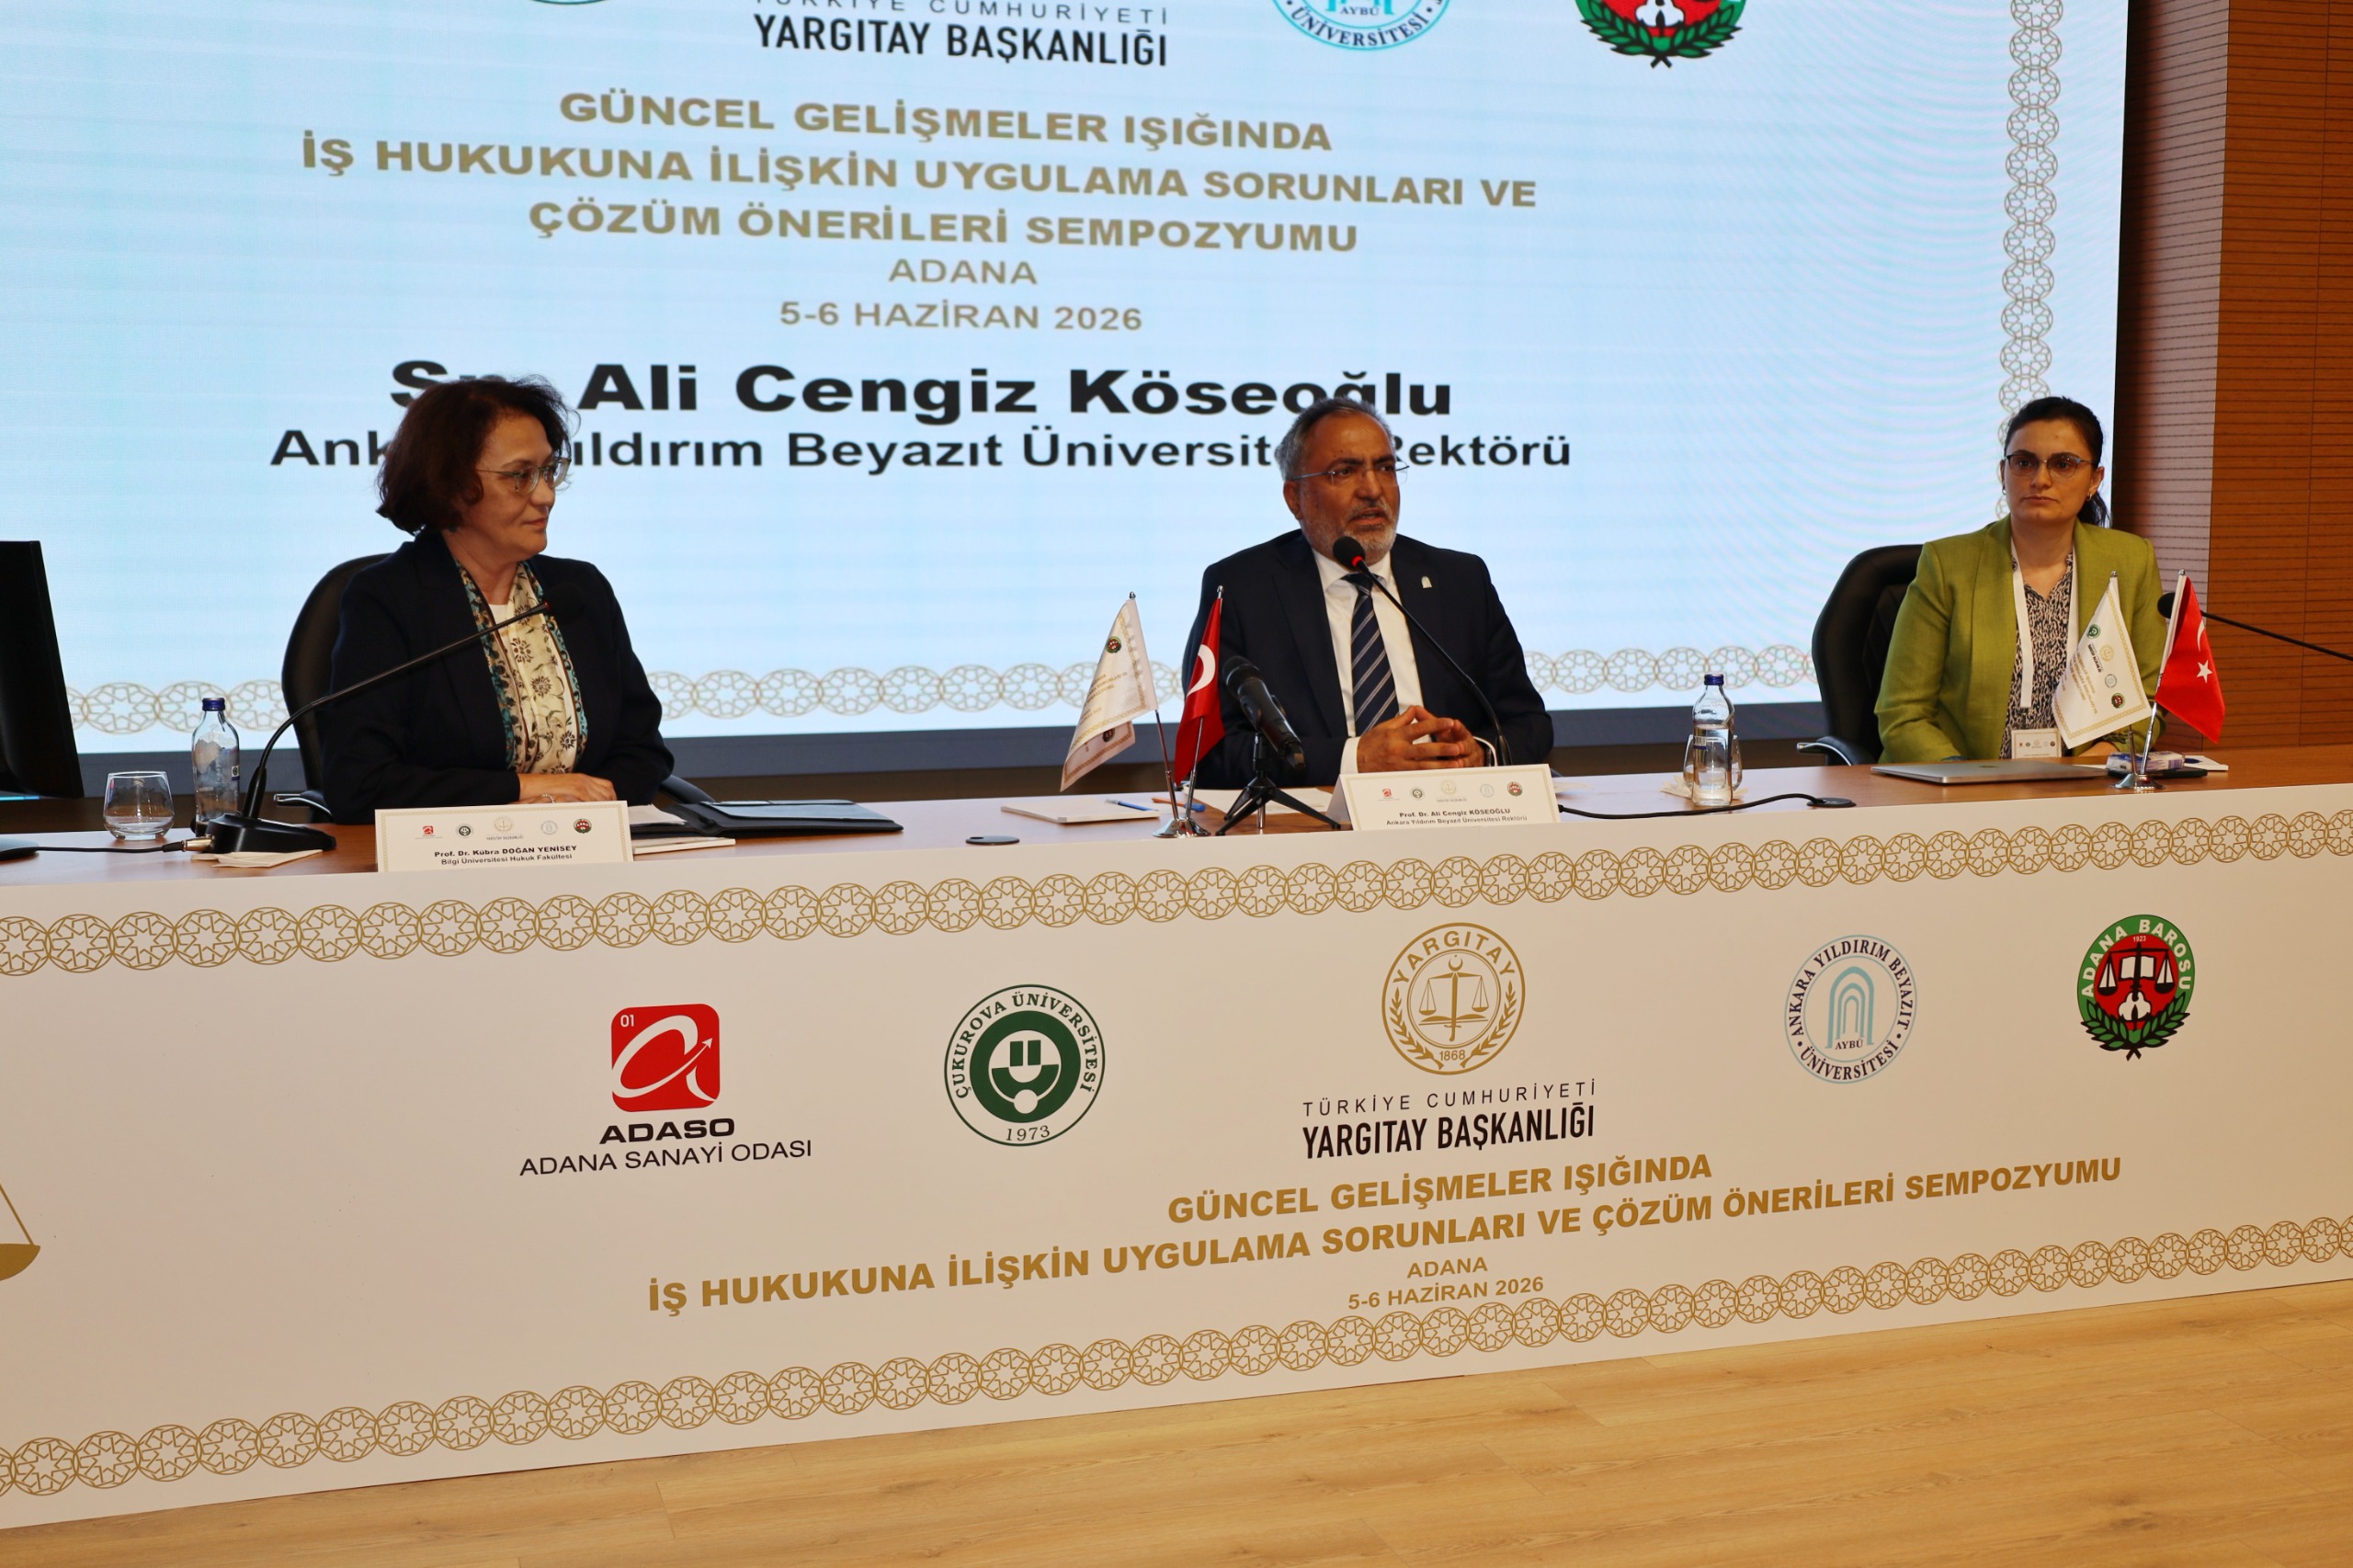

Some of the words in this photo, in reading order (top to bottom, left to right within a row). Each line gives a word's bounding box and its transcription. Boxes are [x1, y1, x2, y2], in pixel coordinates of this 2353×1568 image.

[929, 0, 1167, 25] CUMHURİYETİ
[1290, 6, 1430, 47] ÜNİVERSİTESİ
[1340, 6, 1379, 17] AYBÜ
[753, 13, 930, 55] YARGITAY
[947, 23, 1166, 67] BAŞKANLIĞI
[559, 87, 776, 131] GÜNCEL
[794, 98, 1108, 144] GELİŞMELER
[1124, 112, 1333, 152] IŞIĞINDA
[302, 130, 355, 177] İŞ
[376, 140, 694, 182] HUKUKUNA
[710, 144, 898, 191] İLİŞKİN
[915, 160, 1188, 198] UYGULAMA
[1203, 170, 1463, 206] SORUNLARI
[1481, 178, 1537, 209] VE
[529, 197, 721, 238] ÇÖZÜM
[737, 202, 1007, 244] ÖNERİLERİ
[1026, 216, 1358, 253] SEMPOZYUMU
[888, 258, 1038, 286] ADANA
[779, 301, 839, 326] 5-6
[854, 299, 1040, 330] HAZİRAN
[1054, 305, 1142, 332] 2026
[576, 363, 698, 411] Ali
[734, 364, 1037, 426] Cengiz
[572, 432, 762, 467] ıldırım
[788, 432, 1003, 476] Beyazıt
[538, 845, 577, 853] YENİSEY
[1392, 930, 1515, 984] YARGITAY
[2082, 926, 2128, 997] ADANA
[2138, 919, 2191, 990] BAROSU
[1789, 969, 1816, 1036] ANKARA
[1813, 939, 1891, 968] YILDIRIM
[1888, 957, 1914, 1030] BEYAZIT
[620, 1014, 635, 1028] 01
[951, 1001, 1007, 1099] ÇUKUROVA
[1011, 991, 1097, 1092] ÜNİVERSİTESİ
[1439, 1049, 1466, 1062] 1868
[1800, 1039, 1899, 1080] ÜNİVERSİTESİ
[1835, 1038, 1864, 1050] AYBÜ
[1302, 1094, 1410, 1117] TÜRKİYE
[1427, 1078, 1595, 1108] CUMHURİYETİ
[598, 1118, 735, 1145] ADASO
[1006, 1125, 1051, 1141] 1973
[1302, 1118, 1427, 1160] YARGITAY
[1437, 1101, 1595, 1151] BAŞKANLIĞI
[518, 1153, 618, 1176] ADANA
[624, 1141, 722, 1169] SANAYİ
[731, 1139, 812, 1162] ODASI
[1167, 1186, 1319, 1223] GÜNCEL
[1330, 1167, 1552, 1210] GELİŞMELER
[1563, 1153, 1712, 1197] IŞIĞINDA
[649, 1277, 688, 1317] İŞ
[701, 1263, 936, 1307] HUKUKUNA
[949, 1245, 1090, 1290] İLİŞKİN
[1103, 1232, 1311, 1274] UYGULAMA
[1322, 1212, 1526, 1255] SORUNLARI
[1537, 1207, 1582, 1235] VE
[1592, 1192, 1712, 1237] ÇÖZÜM
[1722, 1177, 1895, 1218] ÖNERİLERİ
[1904, 1156, 2121, 1200] SEMPOZYUMU
[1406, 1256, 1488, 1279] ADANA
[1347, 1291, 1381, 1310] 5-6
[1388, 1281, 1488, 1306] HAZİRAN
[1495, 1276, 1544, 1296] 2026
